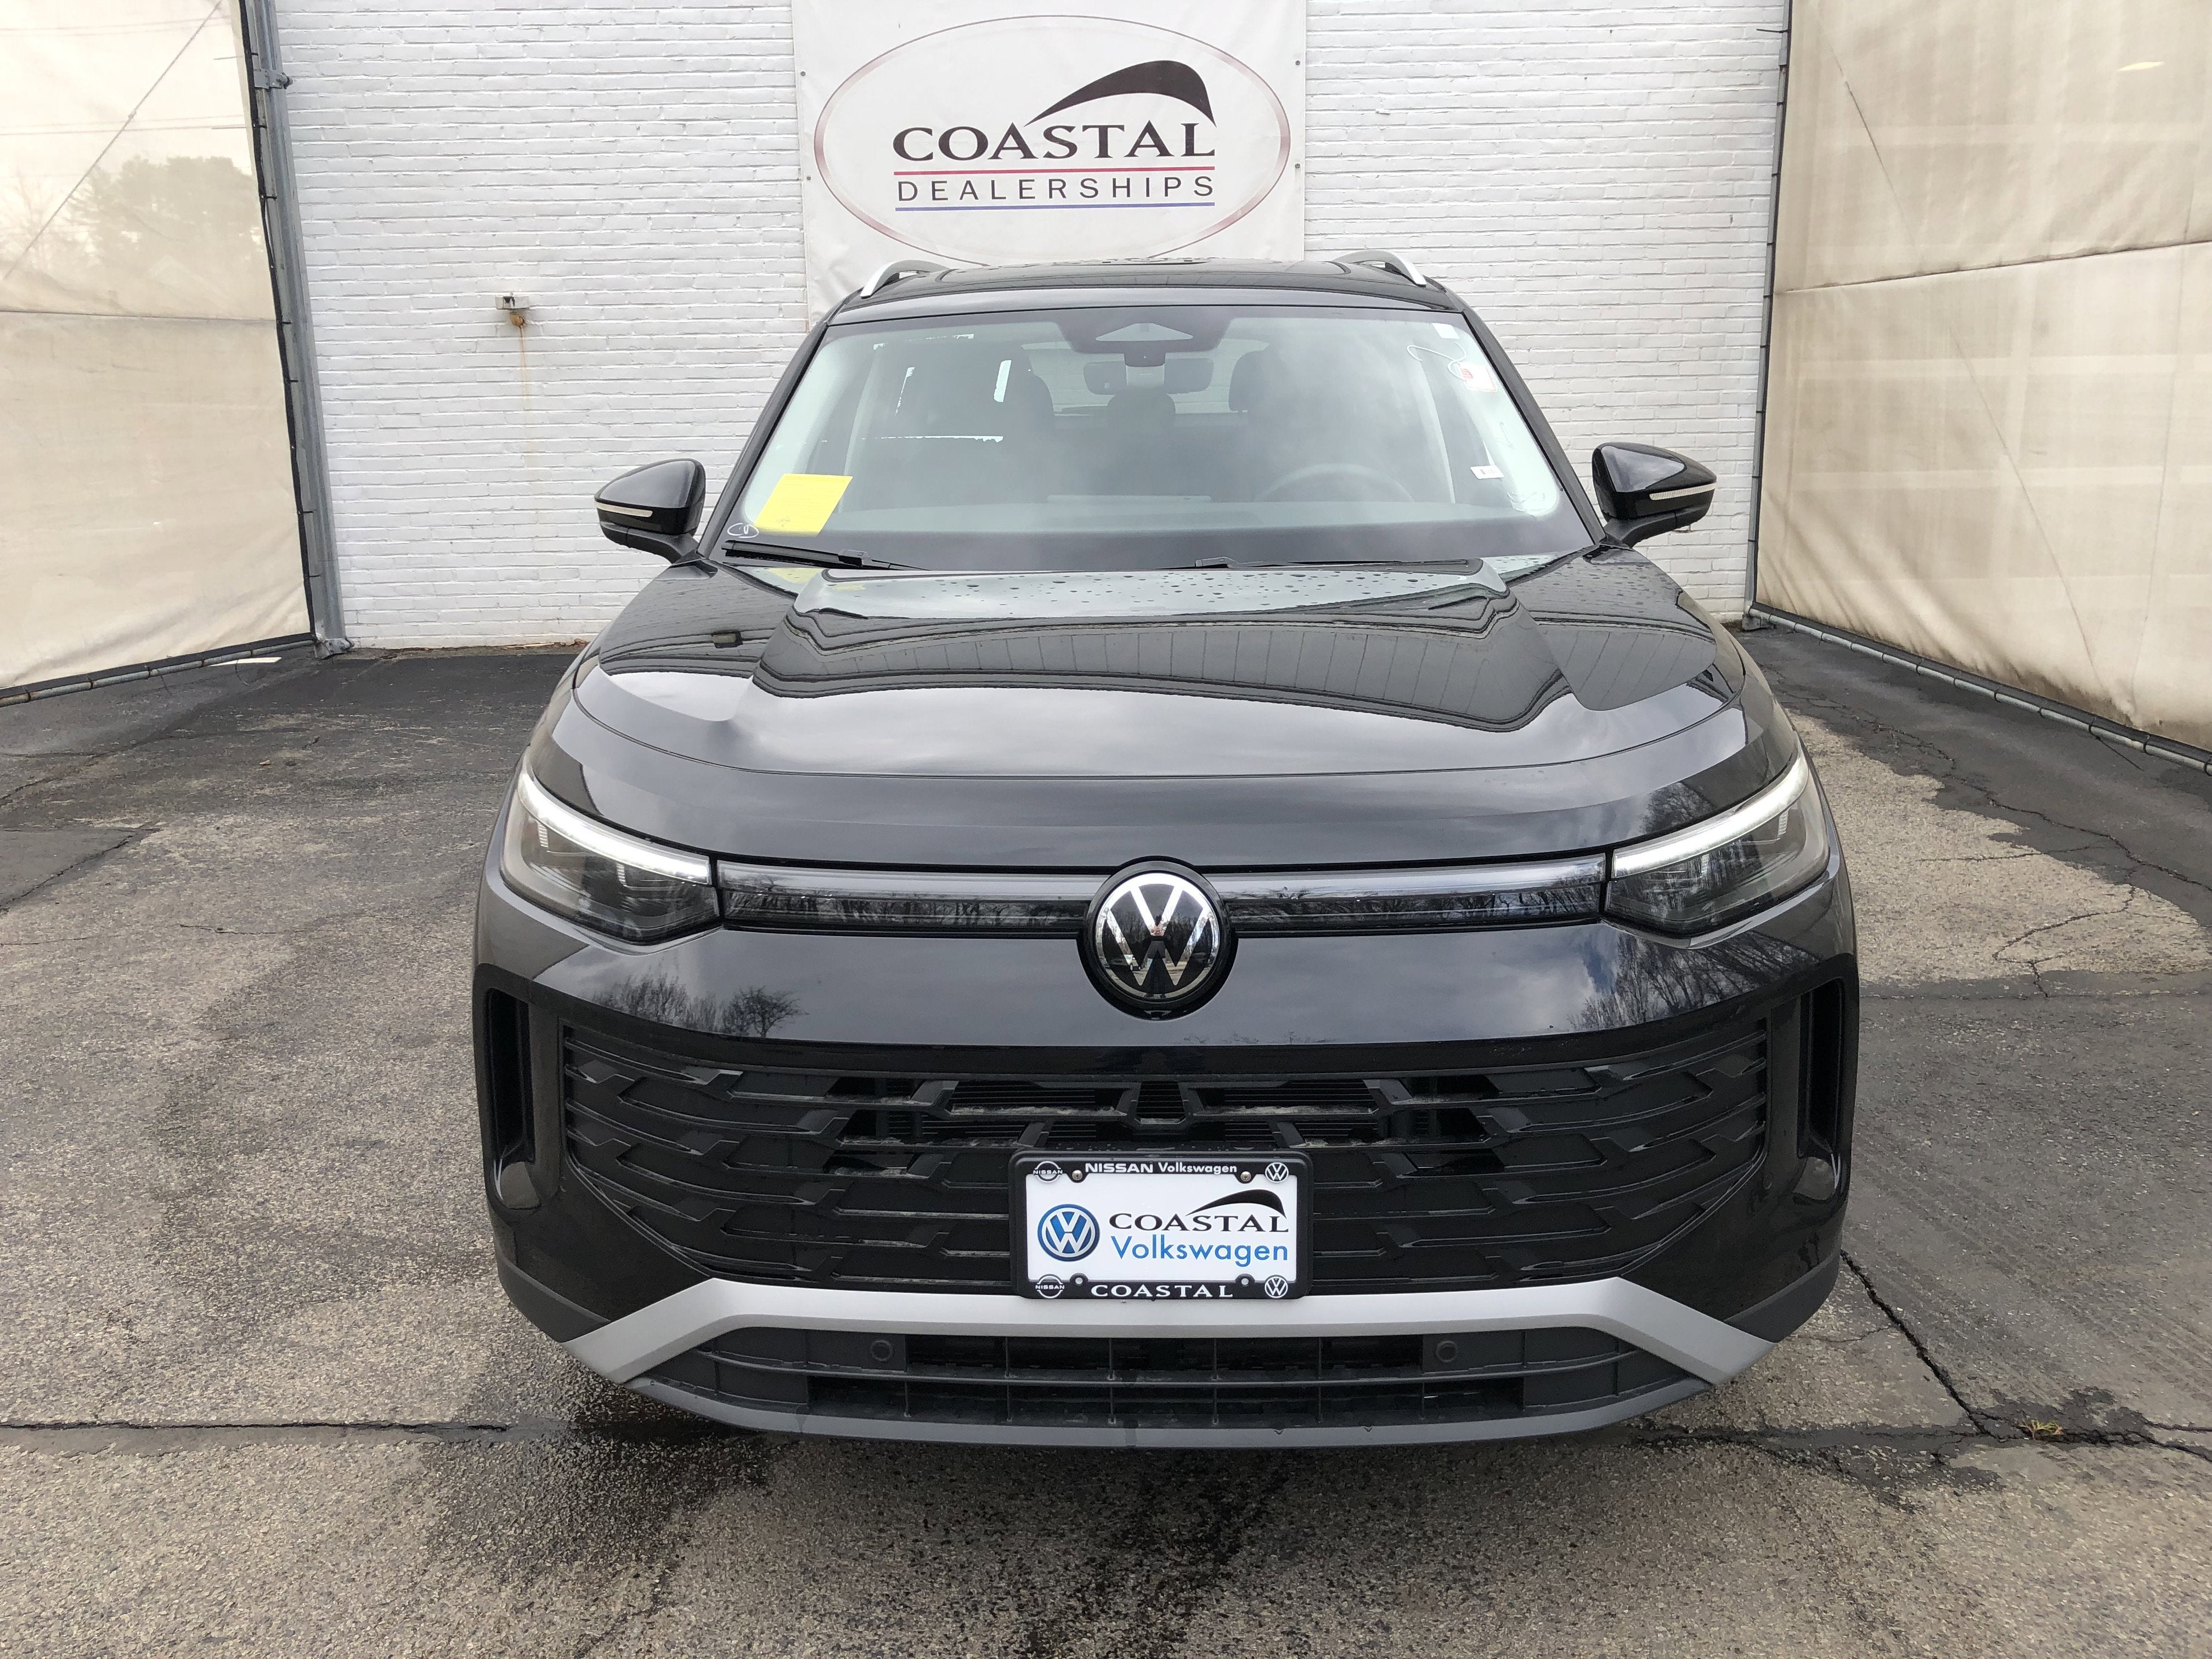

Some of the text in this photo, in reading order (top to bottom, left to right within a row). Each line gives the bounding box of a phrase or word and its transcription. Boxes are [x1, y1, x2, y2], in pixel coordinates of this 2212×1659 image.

[893, 120, 1216, 161] COASTAL
[898, 176, 1214, 202] DEALERSHIPS
[1085, 1162, 1237, 1175] NISSAN Volkswagen
[1109, 1213, 1289, 1233] COASTAL
[1111, 1234, 1288, 1267] Volkswagen
[1091, 1284, 1233, 1297] COASTAL
